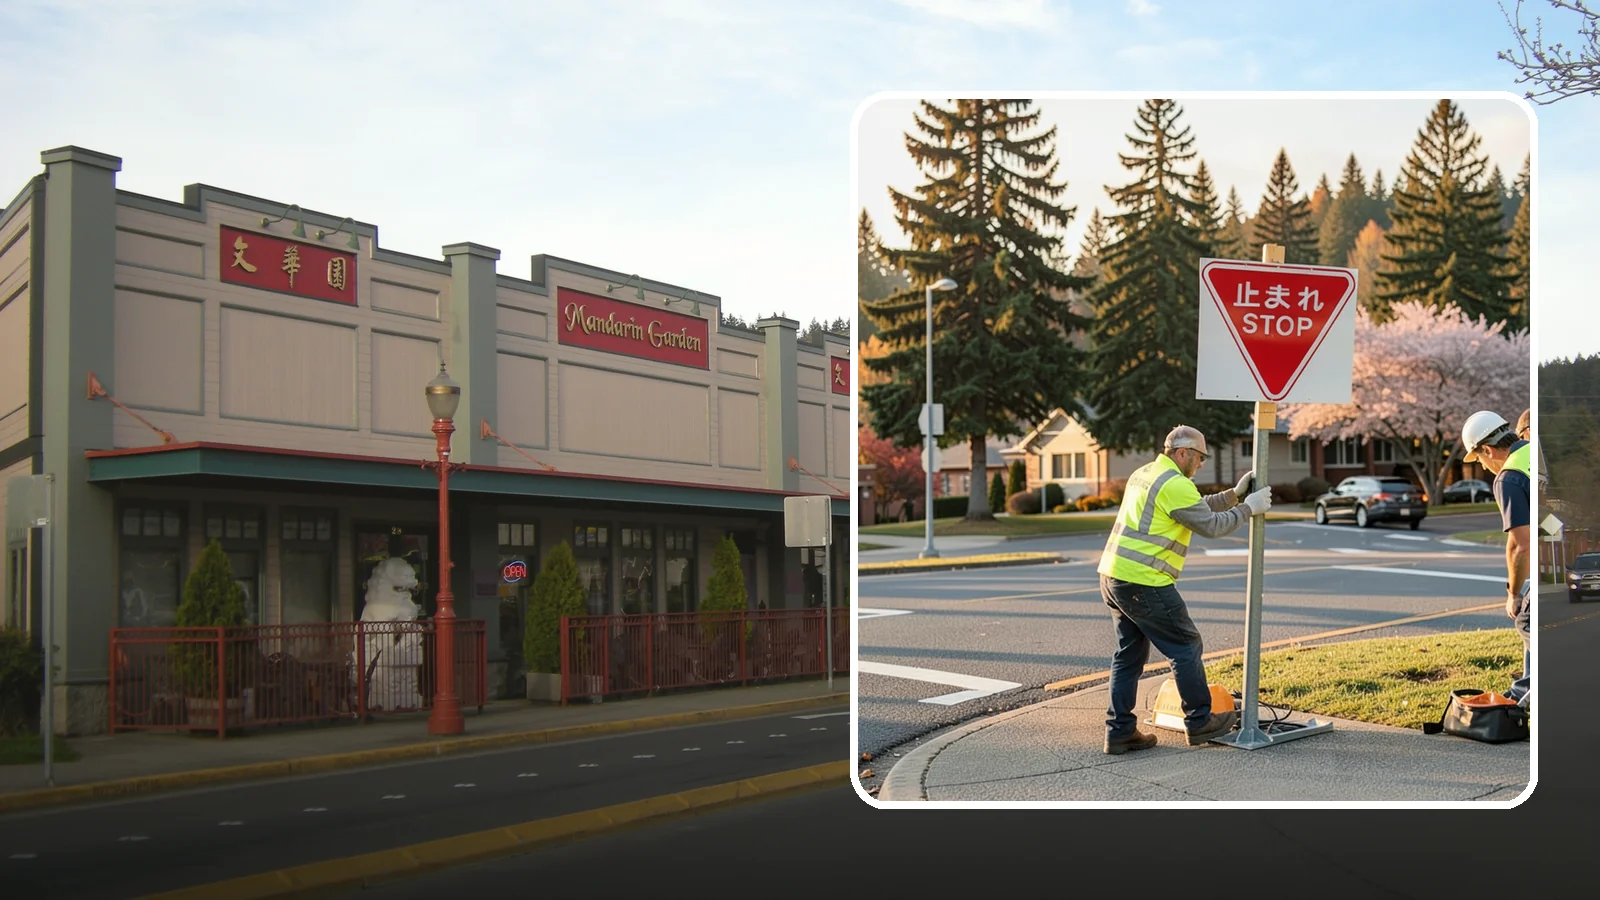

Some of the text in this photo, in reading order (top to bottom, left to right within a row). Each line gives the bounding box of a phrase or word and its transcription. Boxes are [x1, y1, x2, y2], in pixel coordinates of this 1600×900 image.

[230, 235, 346, 291] 文華園
[1233, 281, 1325, 312] 止まれ
[564, 302, 702, 352] Mandarin Garden
[1242, 312, 1313, 337] STOP
[503, 565, 527, 578] OPEN
